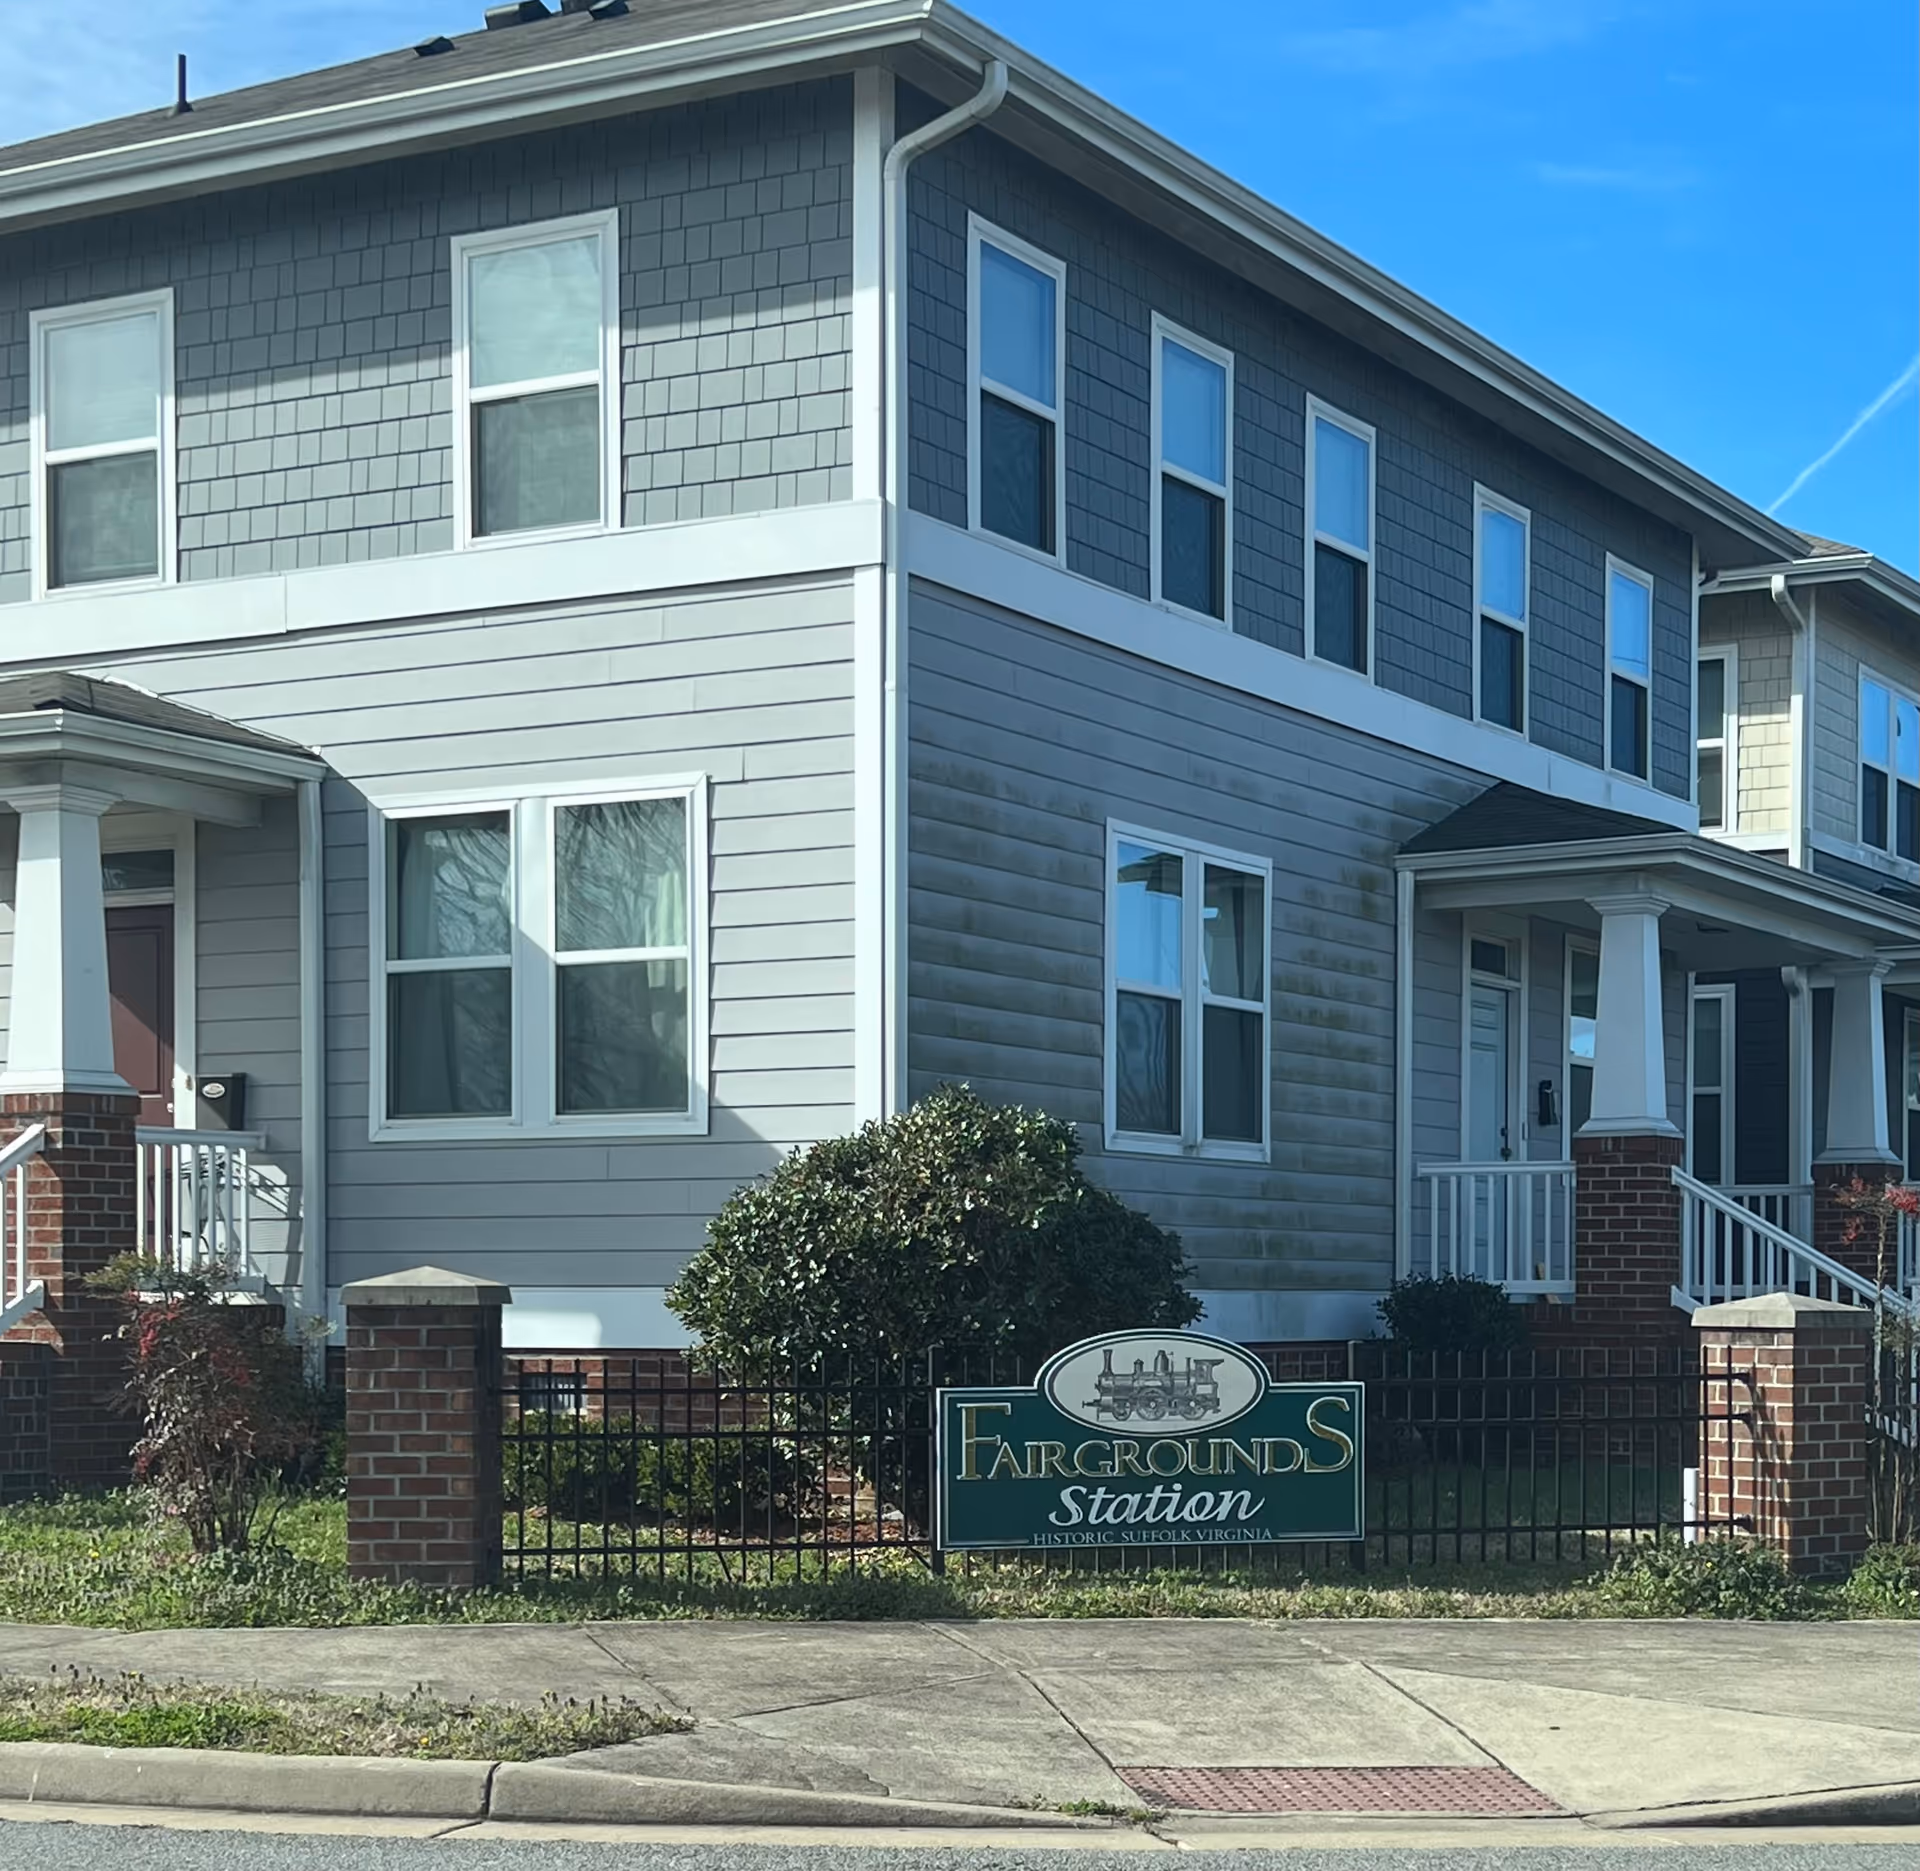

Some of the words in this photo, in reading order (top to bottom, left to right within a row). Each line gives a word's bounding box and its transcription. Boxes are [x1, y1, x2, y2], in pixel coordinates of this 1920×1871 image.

[956, 1396, 1354, 1480] FAIRGROUNDS
[1048, 1483, 1265, 1526] Station
[1033, 1531, 1114, 1545] HISTORIC
[1121, 1529, 1192, 1543] SUFFOLK
[1195, 1527, 1272, 1541] VIRGINIA
